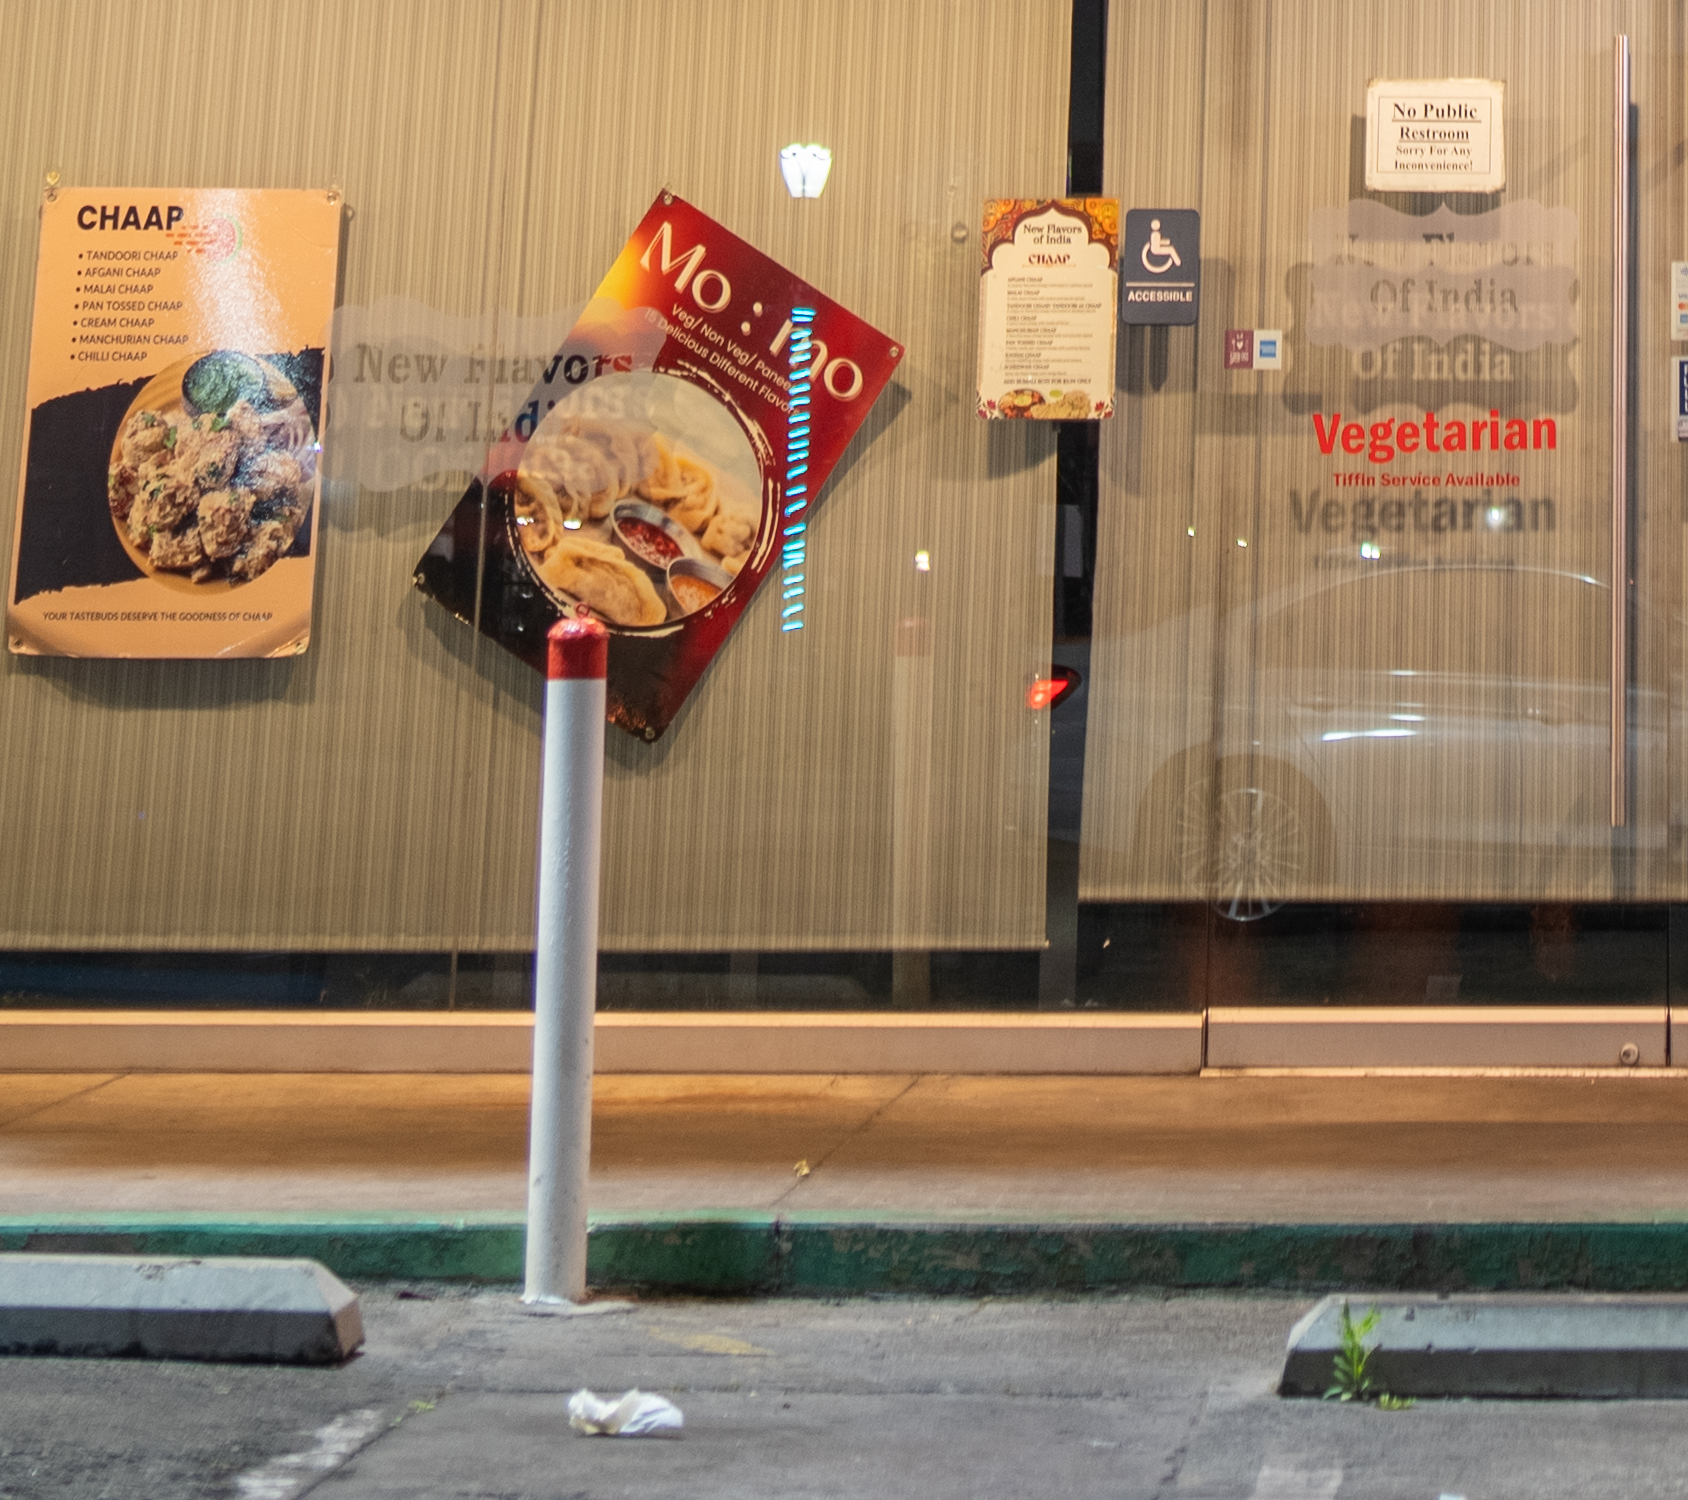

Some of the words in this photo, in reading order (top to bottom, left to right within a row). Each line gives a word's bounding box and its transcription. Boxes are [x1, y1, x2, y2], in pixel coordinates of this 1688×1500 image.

[1394, 103, 1416, 119] No
[1424, 104, 1477, 119] Public
[1400, 126, 1469, 139] Restroom
[1396, 146, 1425, 158] Sorry
[1430, 146, 1448, 155] For
[1452, 146, 1472, 158] Any
[1395, 160, 1473, 171] Inconvenience!
[77, 205, 184, 231] CHAAP
[1024, 224, 1043, 234] New
[1048, 224, 1082, 234] Flavors
[1034, 234, 1045, 244] of
[1046, 234, 1071, 244] India
[87, 251, 141, 260] TANDOORI
[143, 252, 178, 260] CHAAP
[1028, 254, 1070, 265] CHAAP
[85, 268, 123, 277] AFGANI
[126, 268, 160, 277] CHAAP
[640, 220, 732, 314] Mo
[84, 285, 115, 294] MALAI
[118, 285, 153, 294] CHAAP
[1128, 291, 1193, 302] ACCESSIBLE
[1370, 278, 1416, 313] Of
[1426, 278, 1518, 314] India
[82, 302, 103, 311] PAN
[107, 302, 144, 311] TOSSED
[147, 302, 182, 311] CHAAP
[81, 318, 116, 328] CREAM
[119, 319, 154, 328] CHAAP
[80, 335, 150, 344] MANCHURIAN
[153, 335, 188, 344] CHAAP
[672, 303, 703, 330] Veg/
[701, 324, 726, 348] Non
[726, 338, 757, 366] Veg/
[755, 361, 794, 392] Panee
[78, 352, 109, 361] CHILLI
[112, 352, 147, 361] CHAAP
[657, 319, 710, 359] Delicious
[709, 354, 760, 392] Different
[354, 342, 448, 384] New
[1312, 409, 1556, 464] Vegetarian
[1334, 473, 1376, 487] Tiffin
[1380, 472, 1440, 487] Service
[1445, 472, 1520, 487] Available
[43, 612, 67, 621] YOUR
[69, 612, 118, 621] TASTEBUDS
[121, 612, 158, 621] DESERVE
[160, 612, 177, 621] THE
[179, 612, 227, 621] GOODNESS
[229, 612, 240, 621] OF
[242, 612, 273, 621] CHAAP
